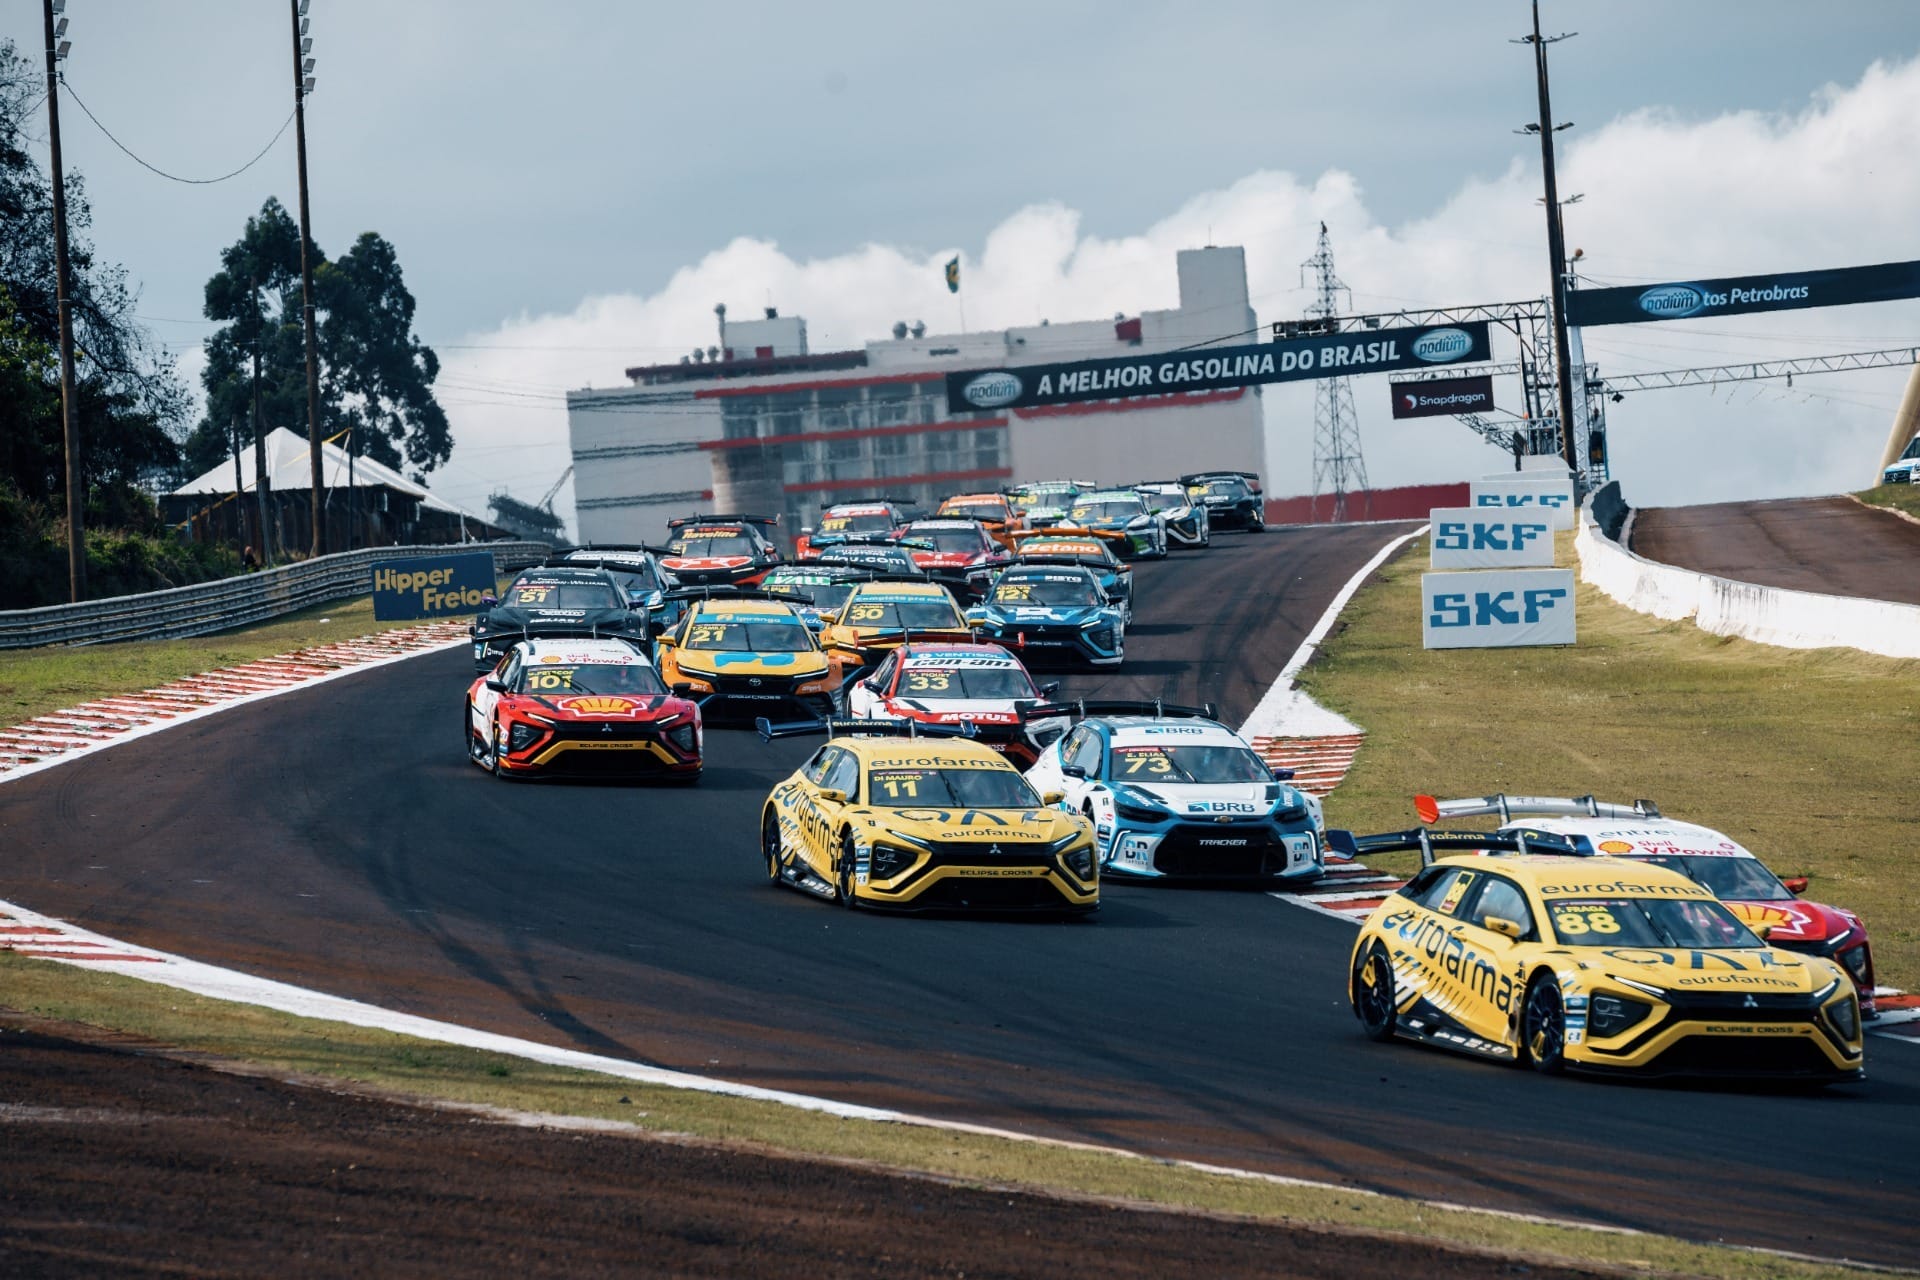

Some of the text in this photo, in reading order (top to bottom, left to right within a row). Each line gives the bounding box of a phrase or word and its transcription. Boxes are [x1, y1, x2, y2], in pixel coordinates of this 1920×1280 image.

[1730, 284, 1809, 304] Petrobras
[1645, 295, 1694, 311] podium
[1419, 337, 1467, 355] podium
[1037, 340, 1401, 396] A MELHOR GASOLINA DO BRASIL
[970, 382, 1016, 399] podium
[1420, 393, 1486, 406] Snapdragon
[1436, 523, 1547, 551] SKF
[374, 568, 454, 594] Hipper
[519, 592, 548, 603] 51
[850, 608, 884, 620] 30
[1430, 588, 1567, 628] SKF
[692, 630, 724, 641] 21
[568, 657, 629, 665] V-Power
[912, 658, 1012, 667] can-am
[529, 675, 572, 689] 101
[909, 677, 950, 690] 33
[832, 719, 893, 728] eurofarma
[940, 712, 1012, 722] MOTUL
[871, 757, 1010, 769] eurofarma
[1125, 757, 1172, 773] 73
[884, 780, 918, 798] 11
[1212, 802, 1256, 812] BRB
[941, 829, 1042, 840] eurofarma
[1199, 839, 1248, 847] TRACKER
[1644, 847, 1737, 856] V-Power
[1541, 880, 1706, 897] eurofarma
[1566, 905, 1609, 913] FRAGA
[1556, 912, 1622, 935] 88
[1383, 907, 1514, 1016] eurofarma
[1678, 973, 1799, 988] eurofarma
[1706, 1025, 1794, 1034] ECLIPSE CROSS
